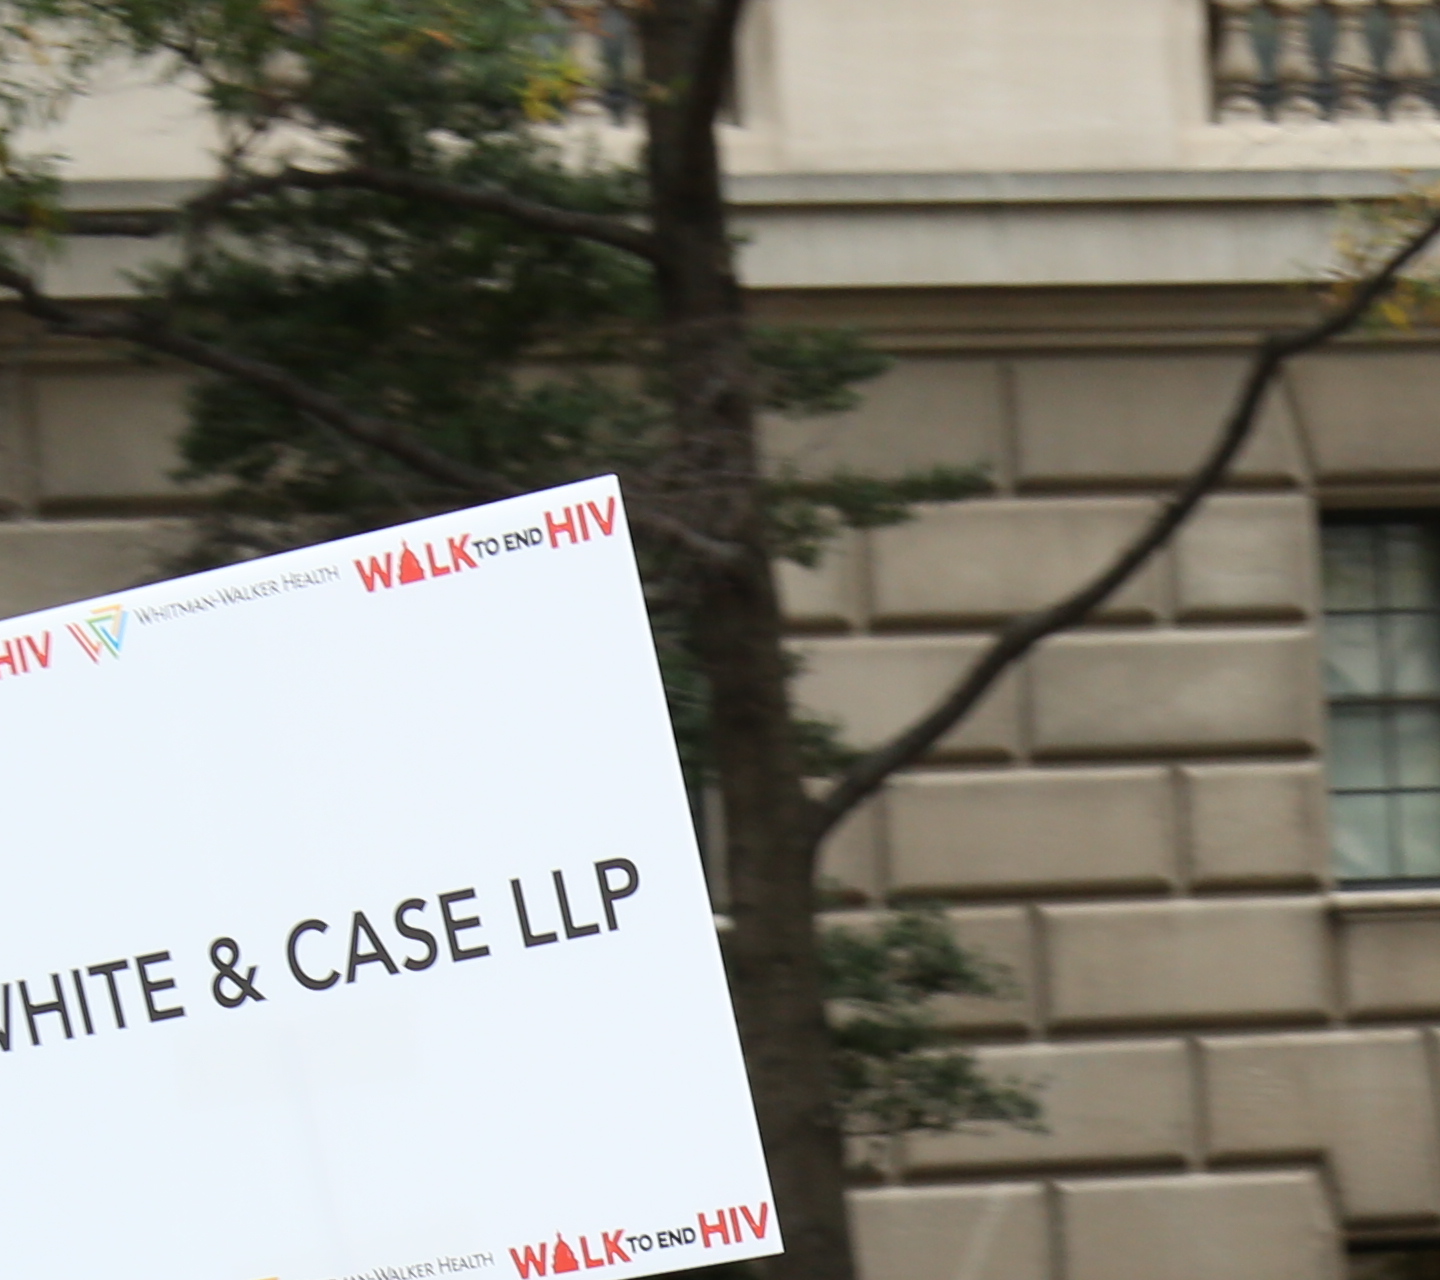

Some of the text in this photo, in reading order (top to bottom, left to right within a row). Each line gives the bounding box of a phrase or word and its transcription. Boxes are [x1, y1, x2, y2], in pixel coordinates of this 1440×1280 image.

[354, 496, 616, 593] WALK TO END HIV
[210, 938, 265, 1008] &
[287, 889, 489, 990] CASE
[511, 858, 638, 947] LLP
[509, 1201, 769, 1280] WALK TO END HIV
